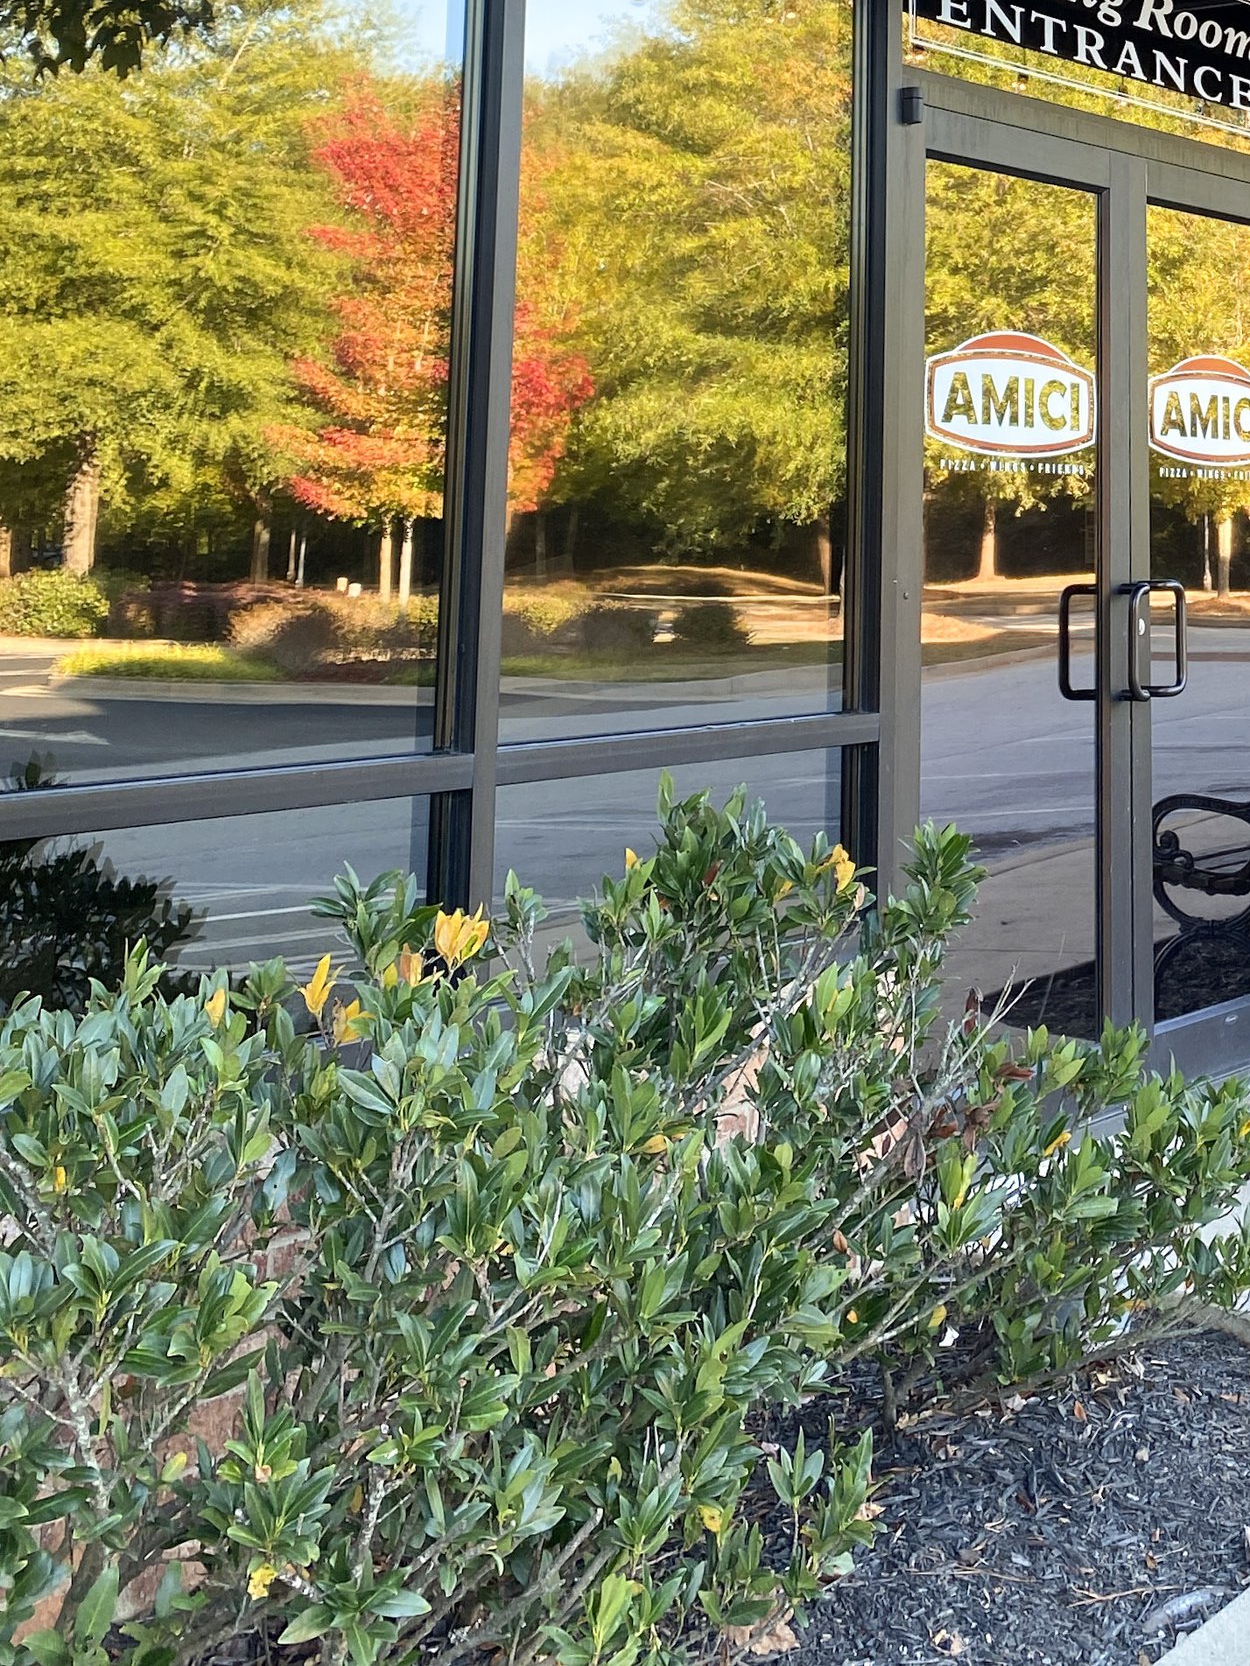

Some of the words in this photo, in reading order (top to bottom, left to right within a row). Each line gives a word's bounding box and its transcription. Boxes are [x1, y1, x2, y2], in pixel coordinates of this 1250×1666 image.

[941, 371, 1080, 432] AMICI
[939, 458, 976, 472] PIZZA
[1159, 466, 1188, 479] PIZZA
